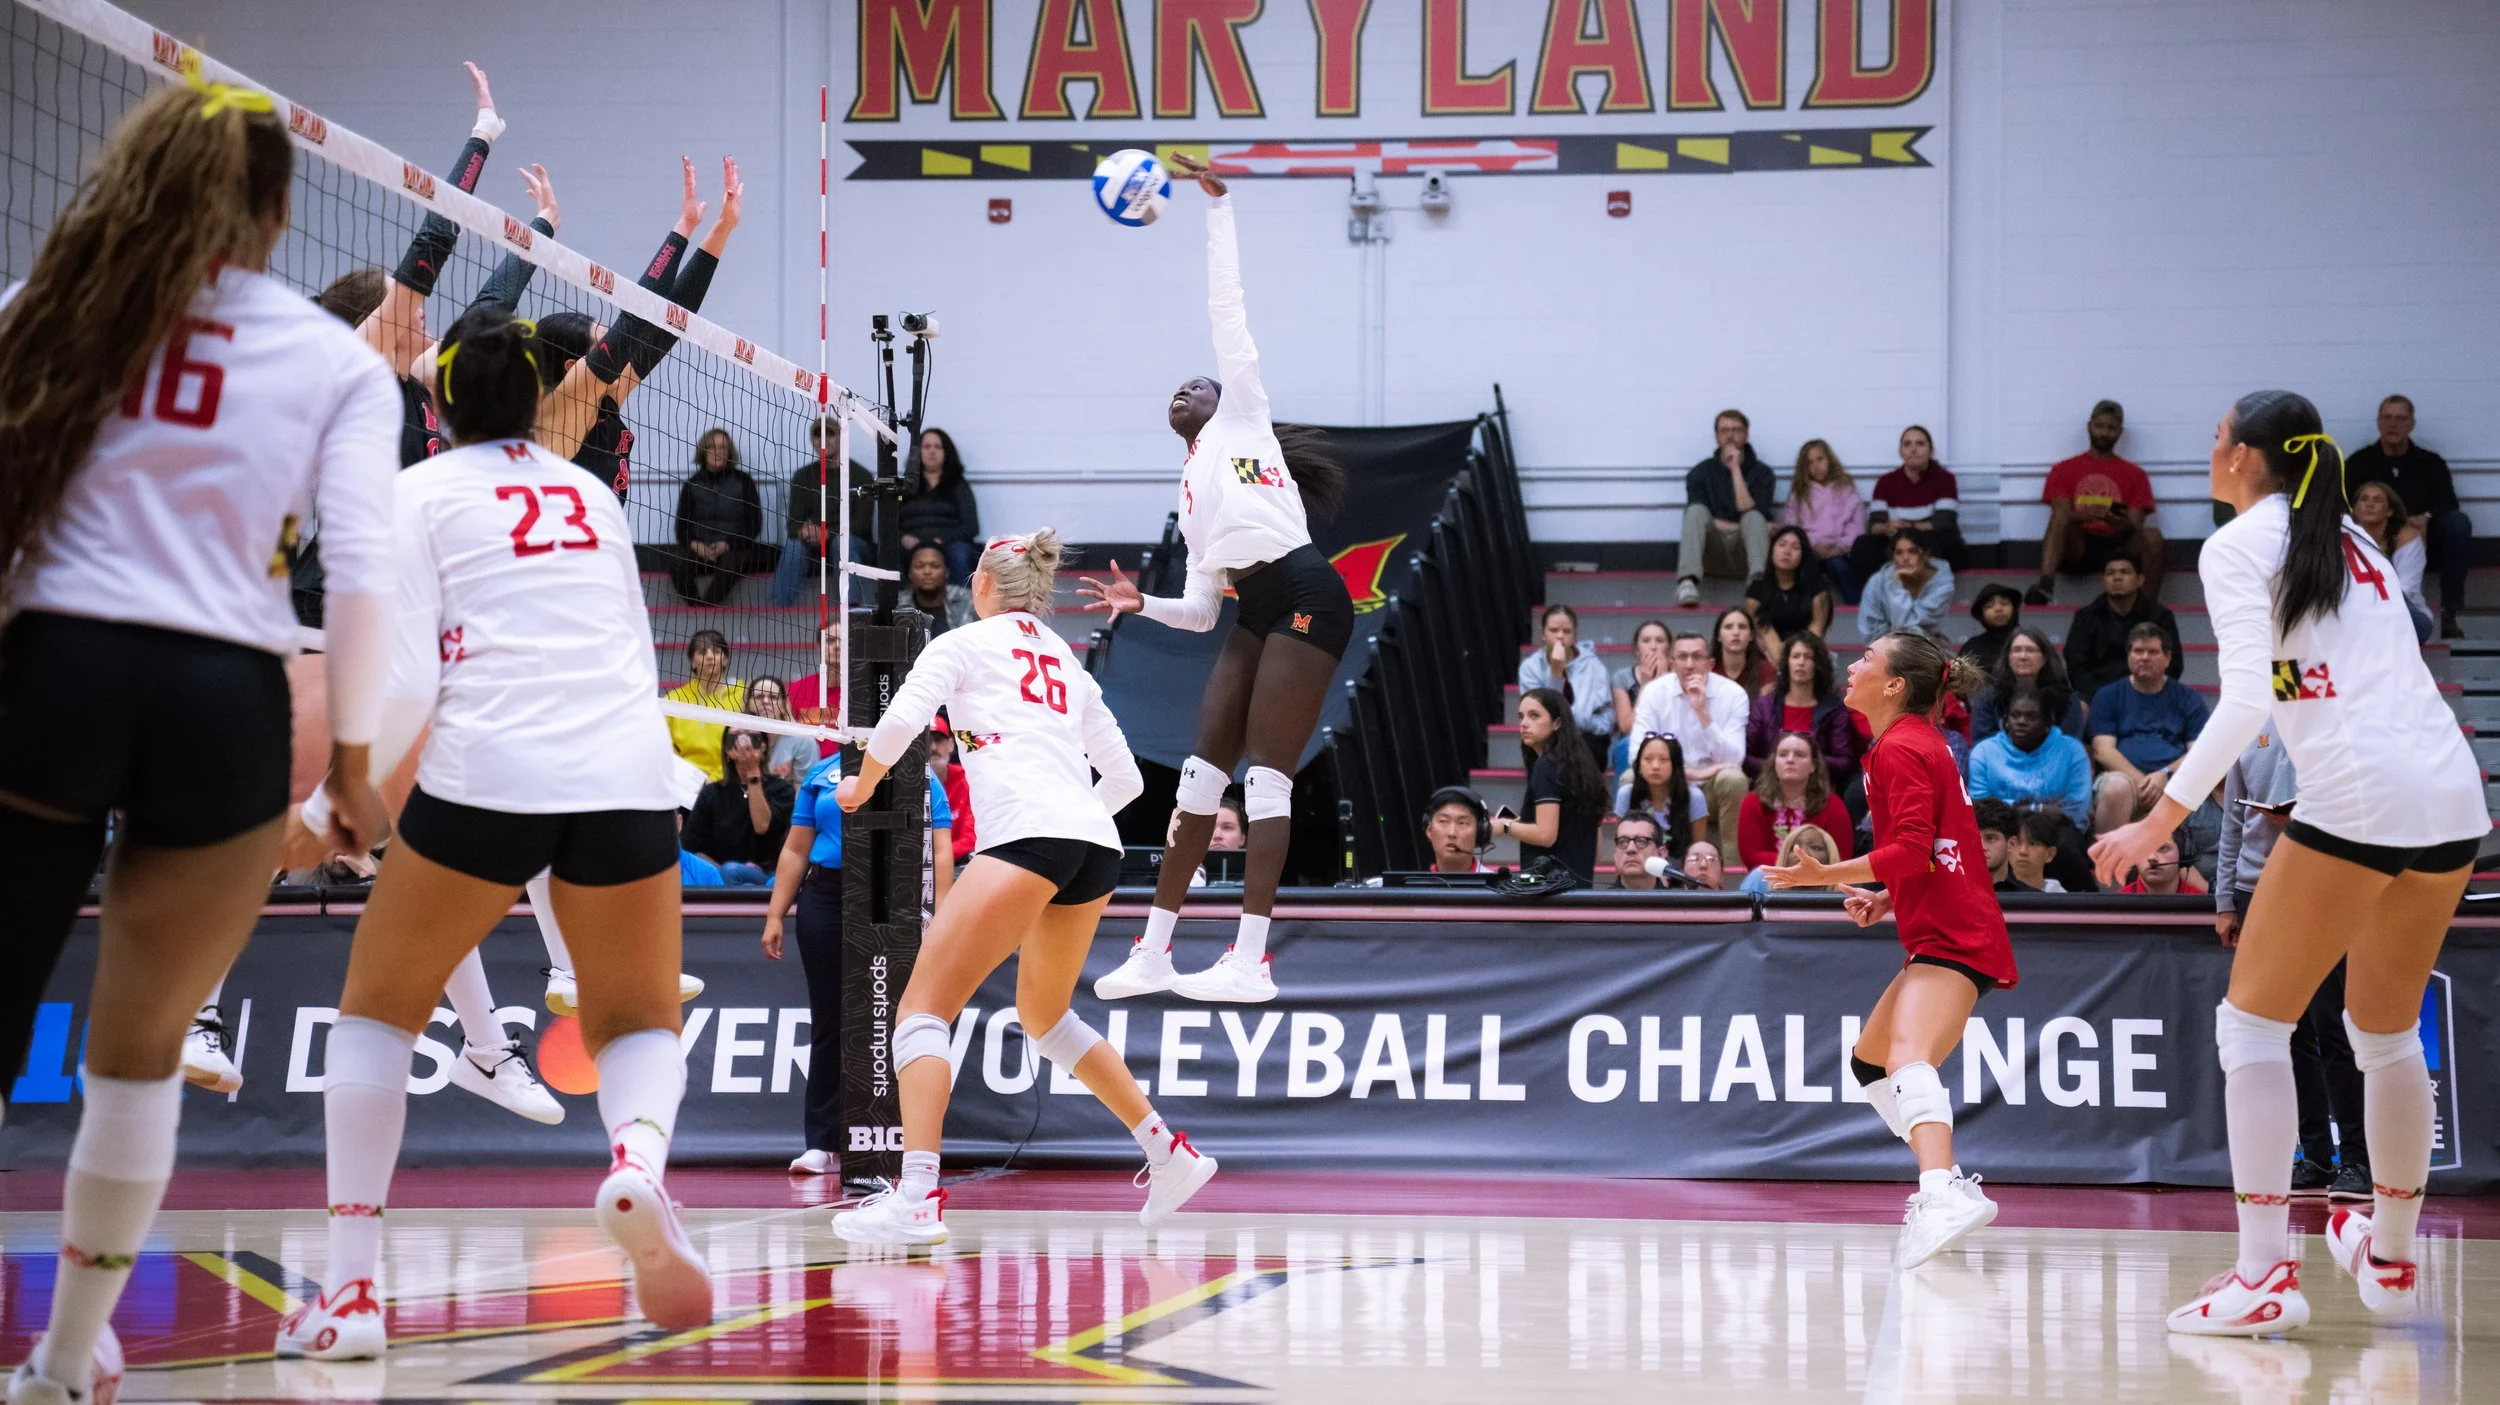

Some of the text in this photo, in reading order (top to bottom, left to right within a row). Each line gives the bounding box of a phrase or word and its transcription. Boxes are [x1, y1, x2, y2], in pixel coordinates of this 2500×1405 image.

[844, 0, 1937, 123] MARYLAND
[502, 442, 536, 463] M
[495, 486, 599, 558] 23
[1016, 619, 1040, 638] M
[1291, 612, 1313, 634] M
[1012, 648, 1068, 715] 26
[869, 955, 890, 1097] sports imports
[1567, 1014, 2167, 1109] CHALLNGE
